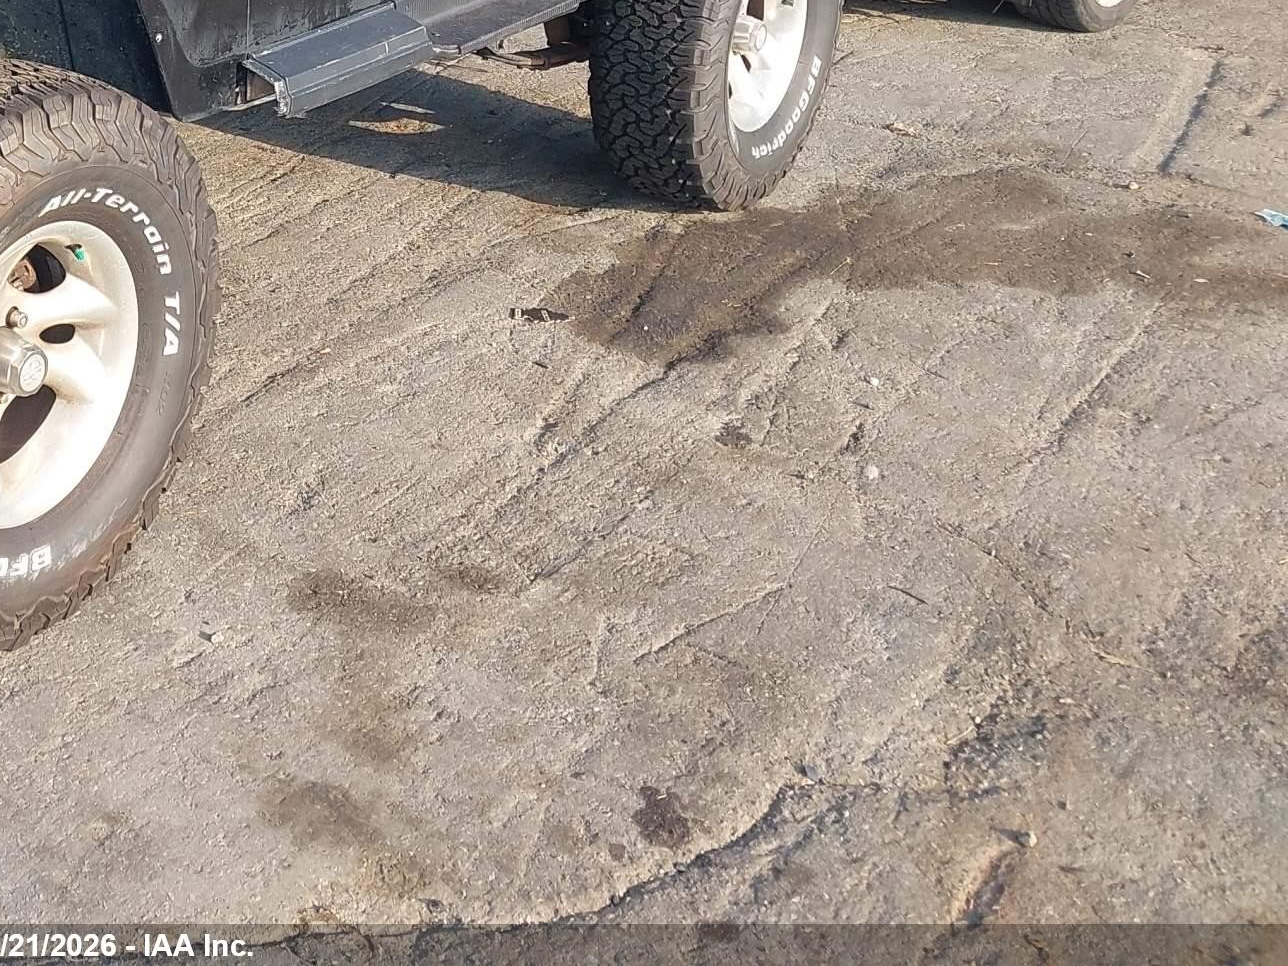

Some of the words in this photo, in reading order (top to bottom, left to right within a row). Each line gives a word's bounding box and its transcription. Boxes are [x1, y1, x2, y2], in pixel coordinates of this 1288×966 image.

[750, 54, 823, 161] BFGoodrich
[38, 186, 174, 276] All-Terrain
[162, 290, 182, 357] T/A
